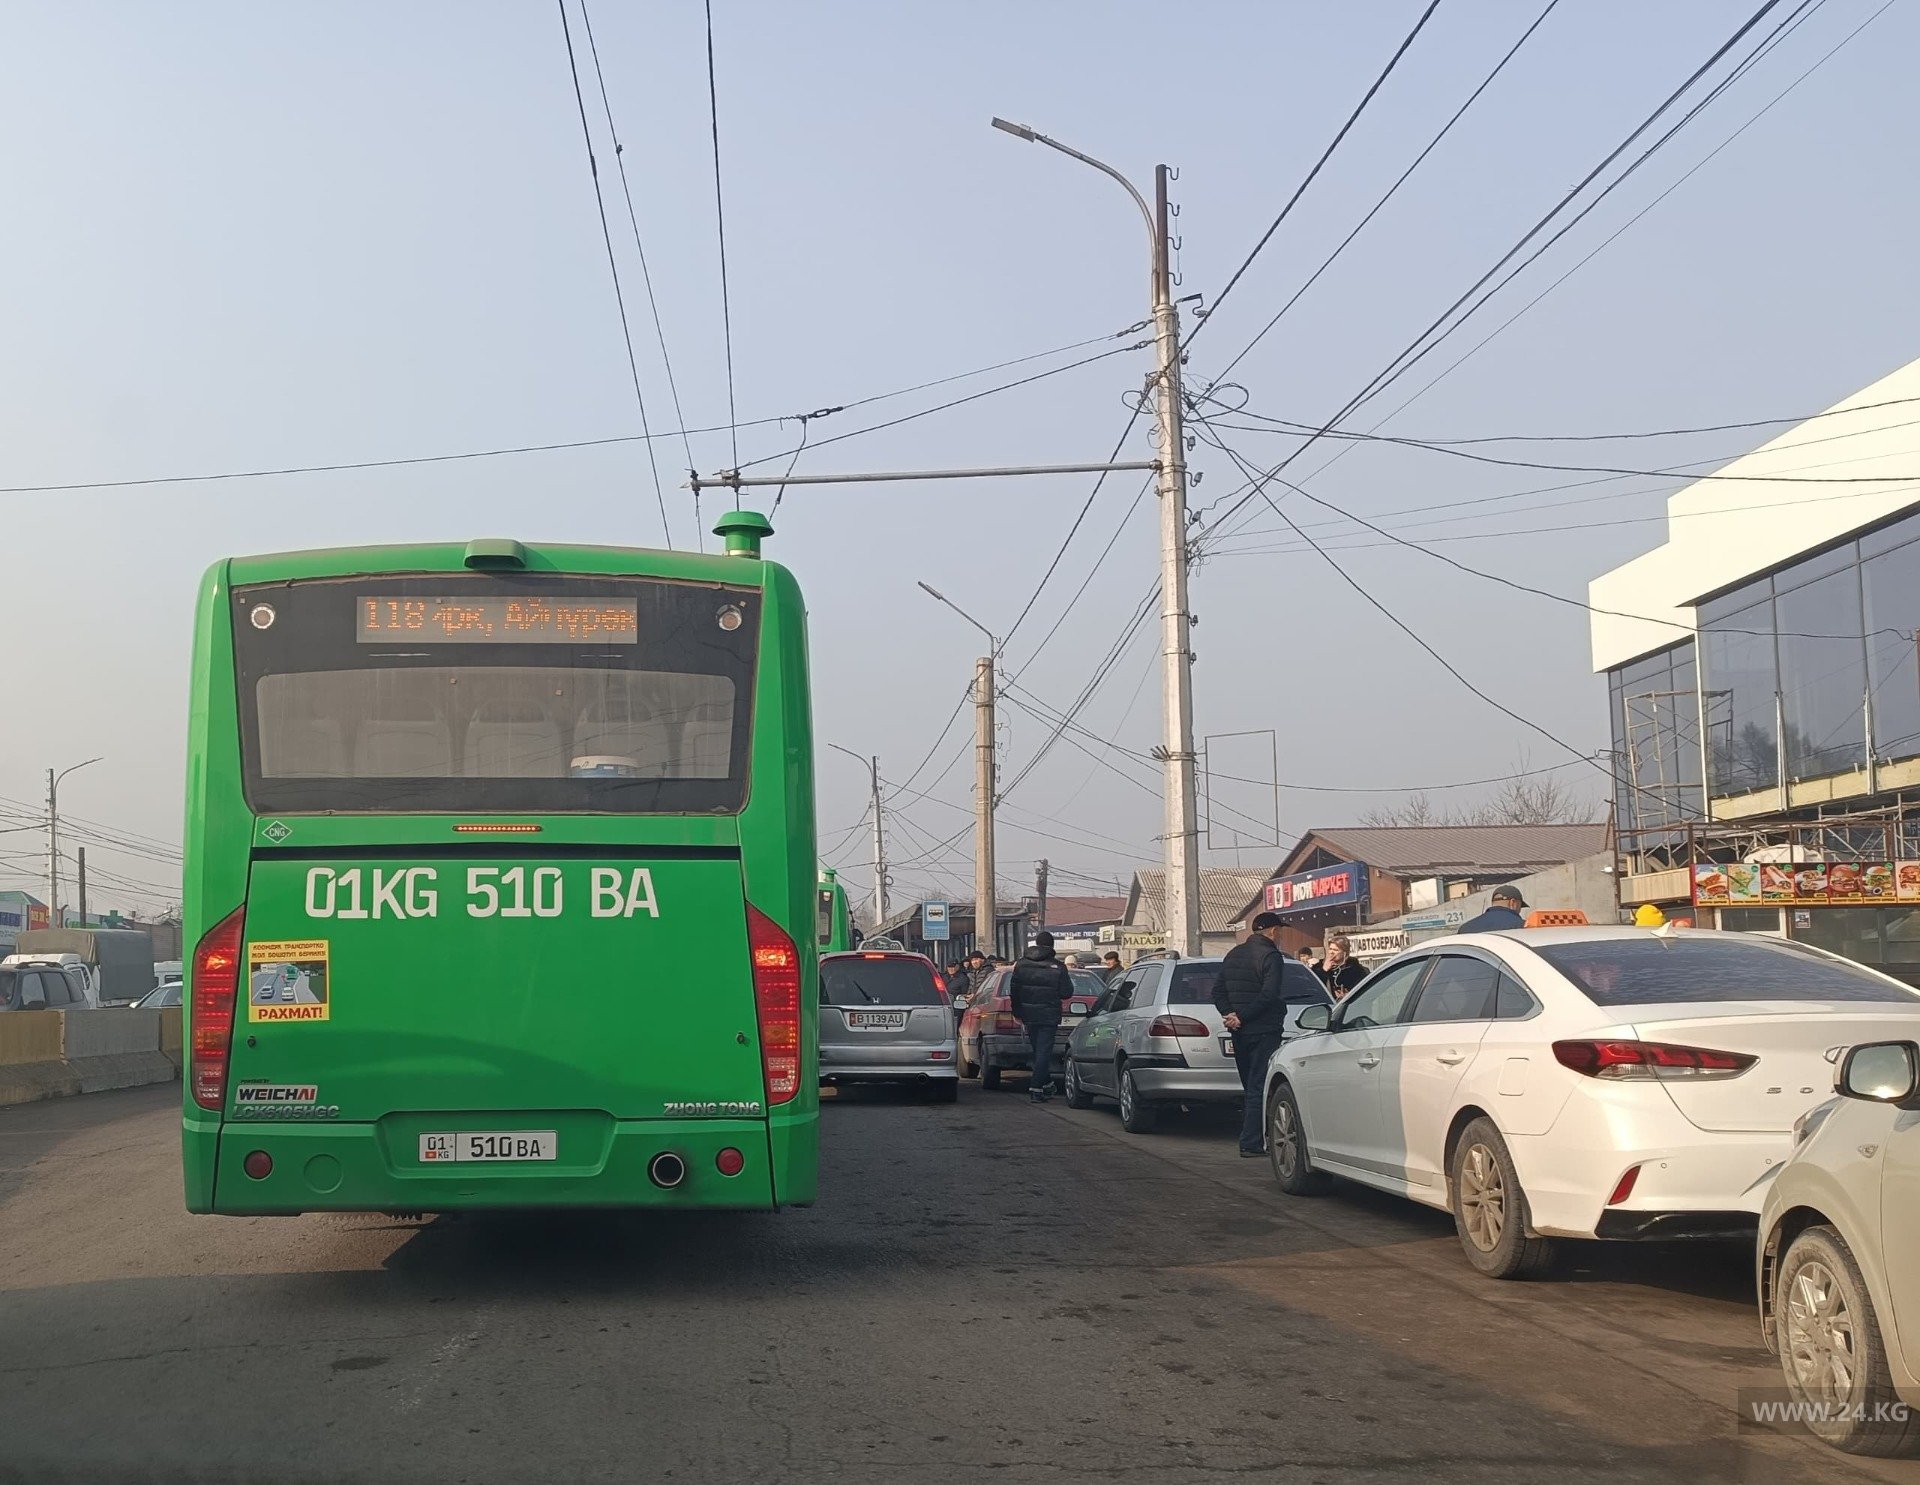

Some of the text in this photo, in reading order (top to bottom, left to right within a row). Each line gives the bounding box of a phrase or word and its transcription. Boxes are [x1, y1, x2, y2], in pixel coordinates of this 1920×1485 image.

[366, 601, 425, 628] 118
[269, 827, 286, 837] CNG
[305, 867, 660, 919] 01KG 510 BA
[1446, 911, 1464, 923] 231
[258, 1007, 323, 1020] РАХМАТ!
[239, 1088, 316, 1101] WEICHAI
[663, 1102, 760, 1116] ZHONG TONG
[427, 1136, 446, 1150] 01
[437, 1151, 450, 1159] KG
